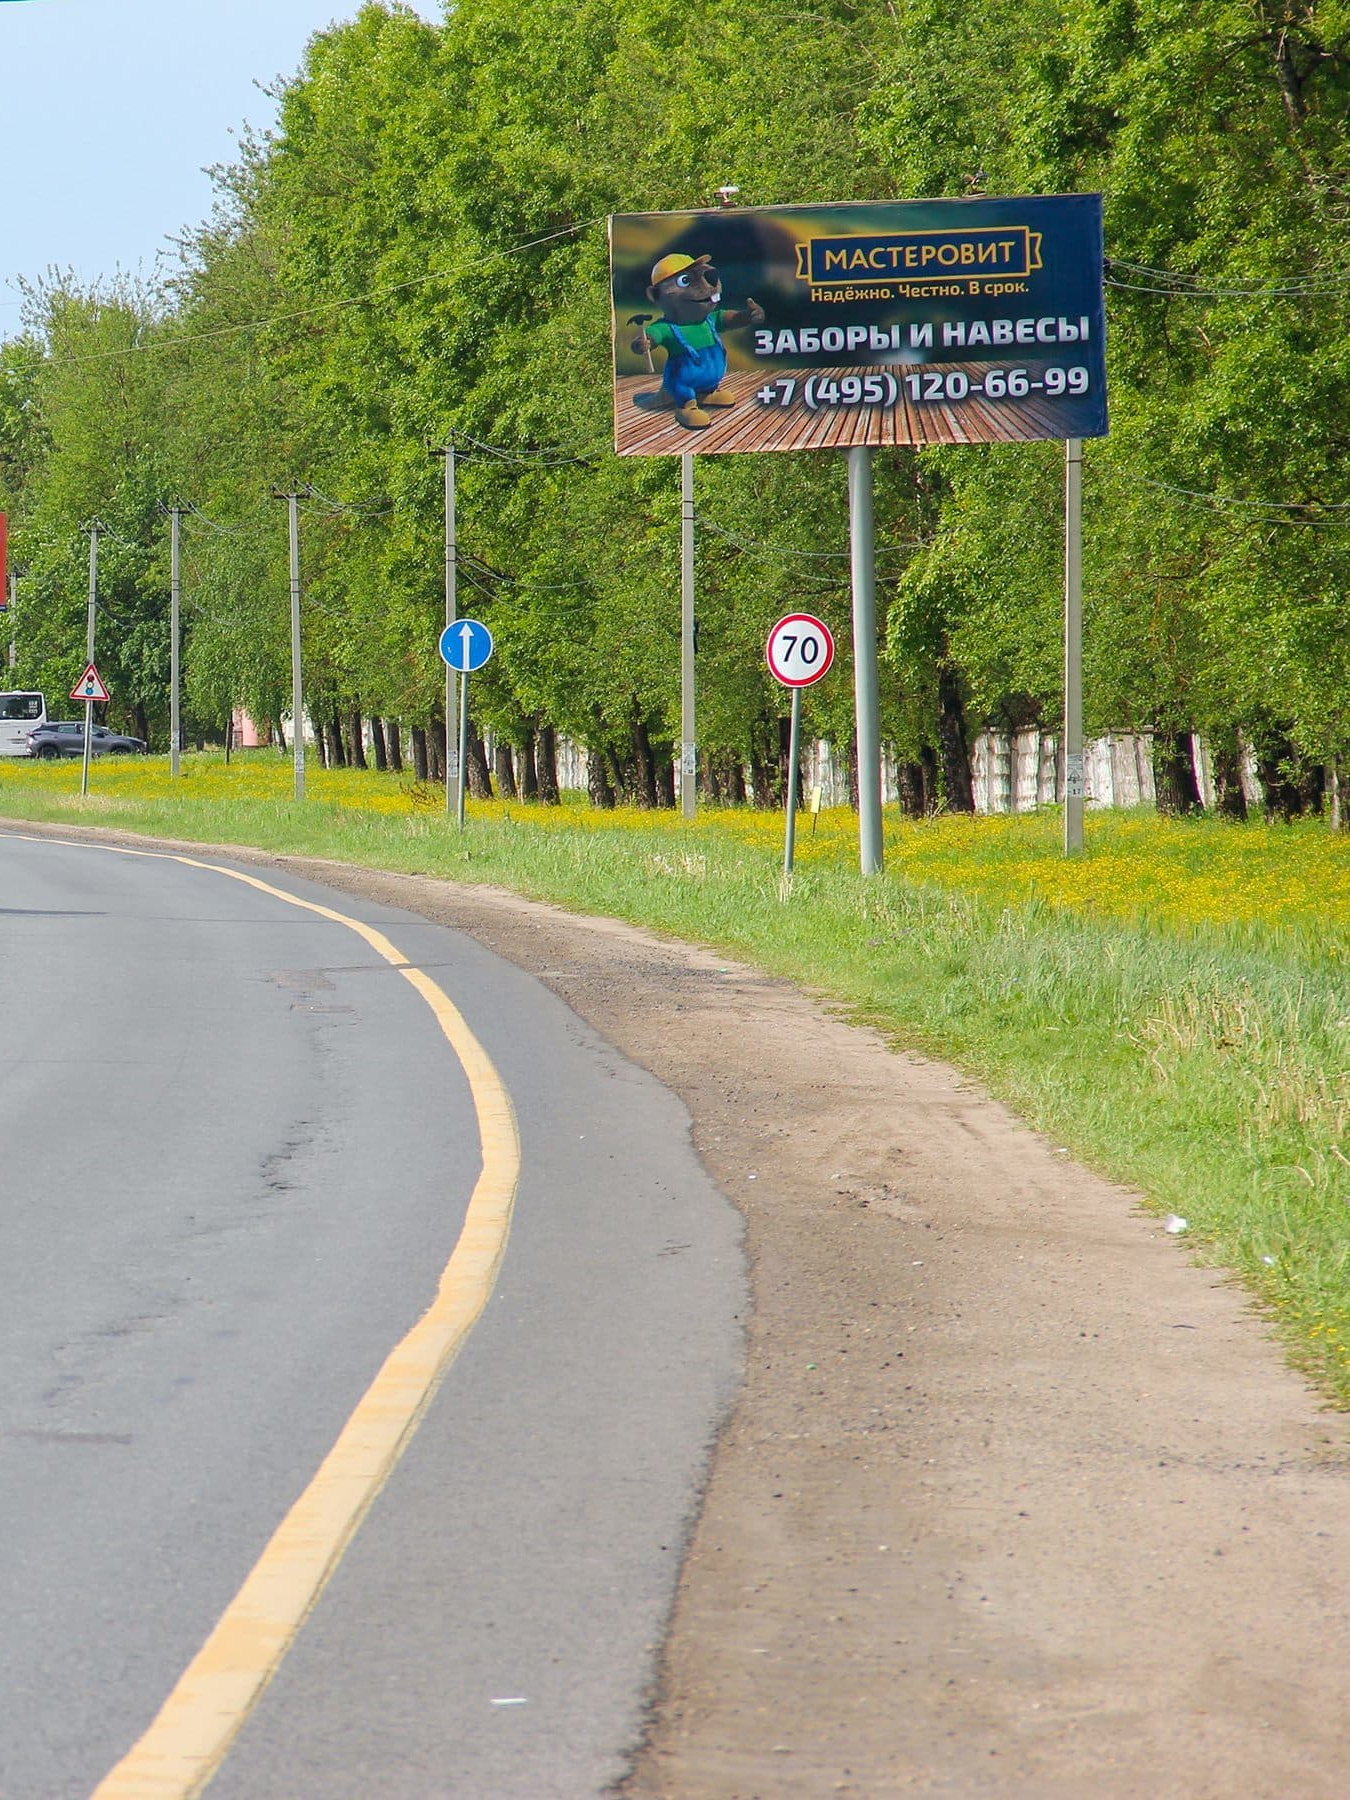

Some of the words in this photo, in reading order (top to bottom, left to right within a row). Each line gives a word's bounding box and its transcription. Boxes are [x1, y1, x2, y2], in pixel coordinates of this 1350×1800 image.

[825, 241, 1016, 270] МАСТЕРОВИТ
[811, 286, 895, 303] Надёжно.
[899, 283, 965, 298] Честно.
[969, 281, 980, 294] В
[985, 281, 1029, 297] срок.
[754, 324, 900, 355] ЗАБОРЫ
[910, 323, 933, 348] И
[943, 316, 1090, 347] НАВЕСЫ
[757, 378, 796, 406] +7
[804, 372, 898, 410] (495)
[906, 366, 1089, 401] 120-66-99
[782, 635, 819, 665] 70
